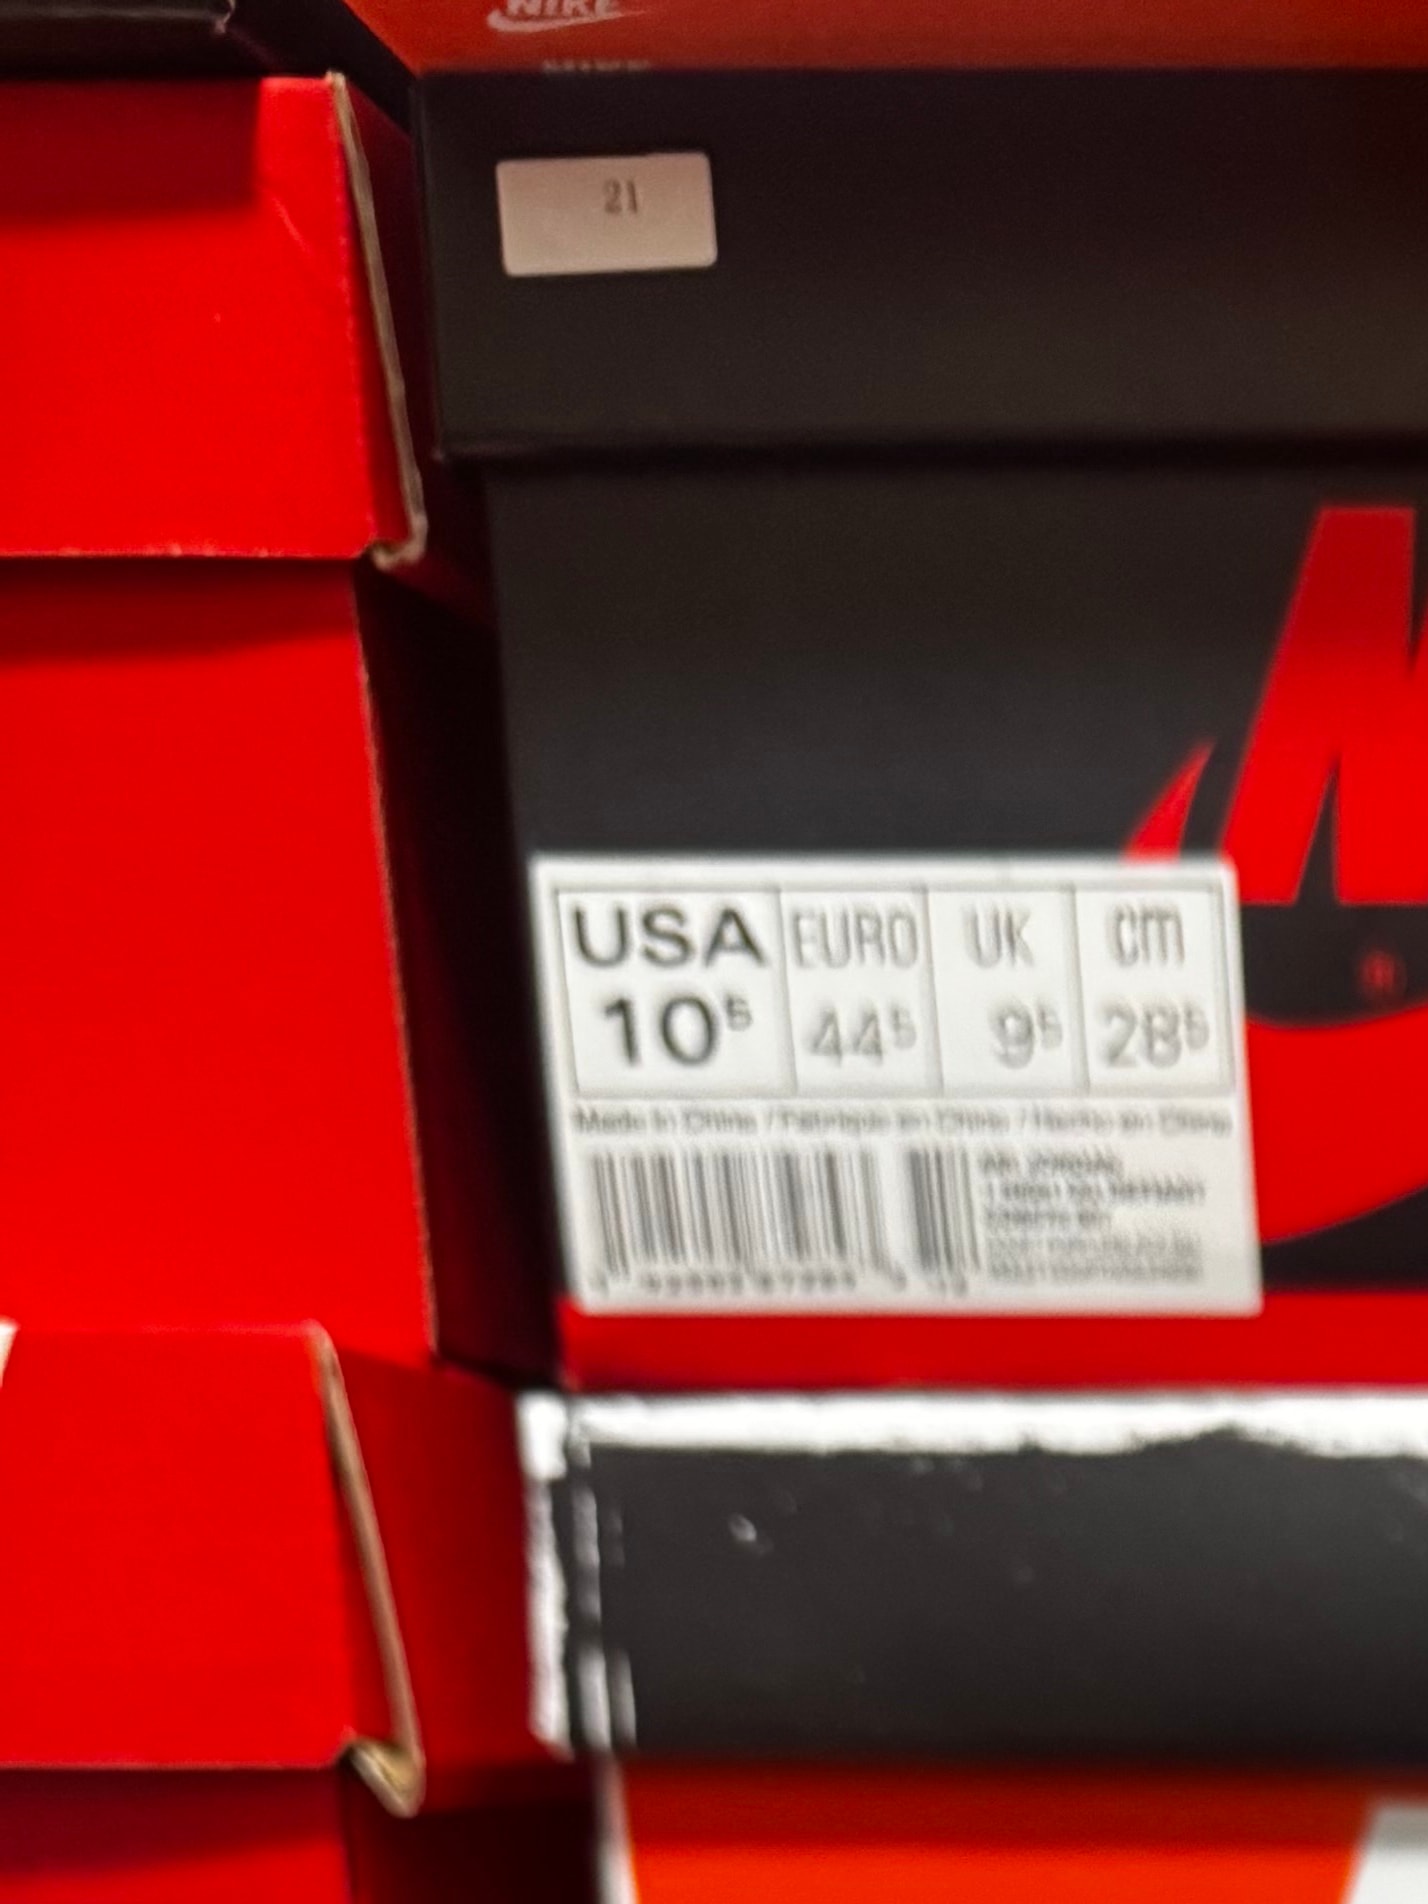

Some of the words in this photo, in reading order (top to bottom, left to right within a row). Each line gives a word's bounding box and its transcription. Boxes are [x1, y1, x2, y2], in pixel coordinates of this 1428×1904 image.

[572, 904, 767, 969] USA
[792, 904, 920, 970] EURO
[963, 902, 1034, 969] UK
